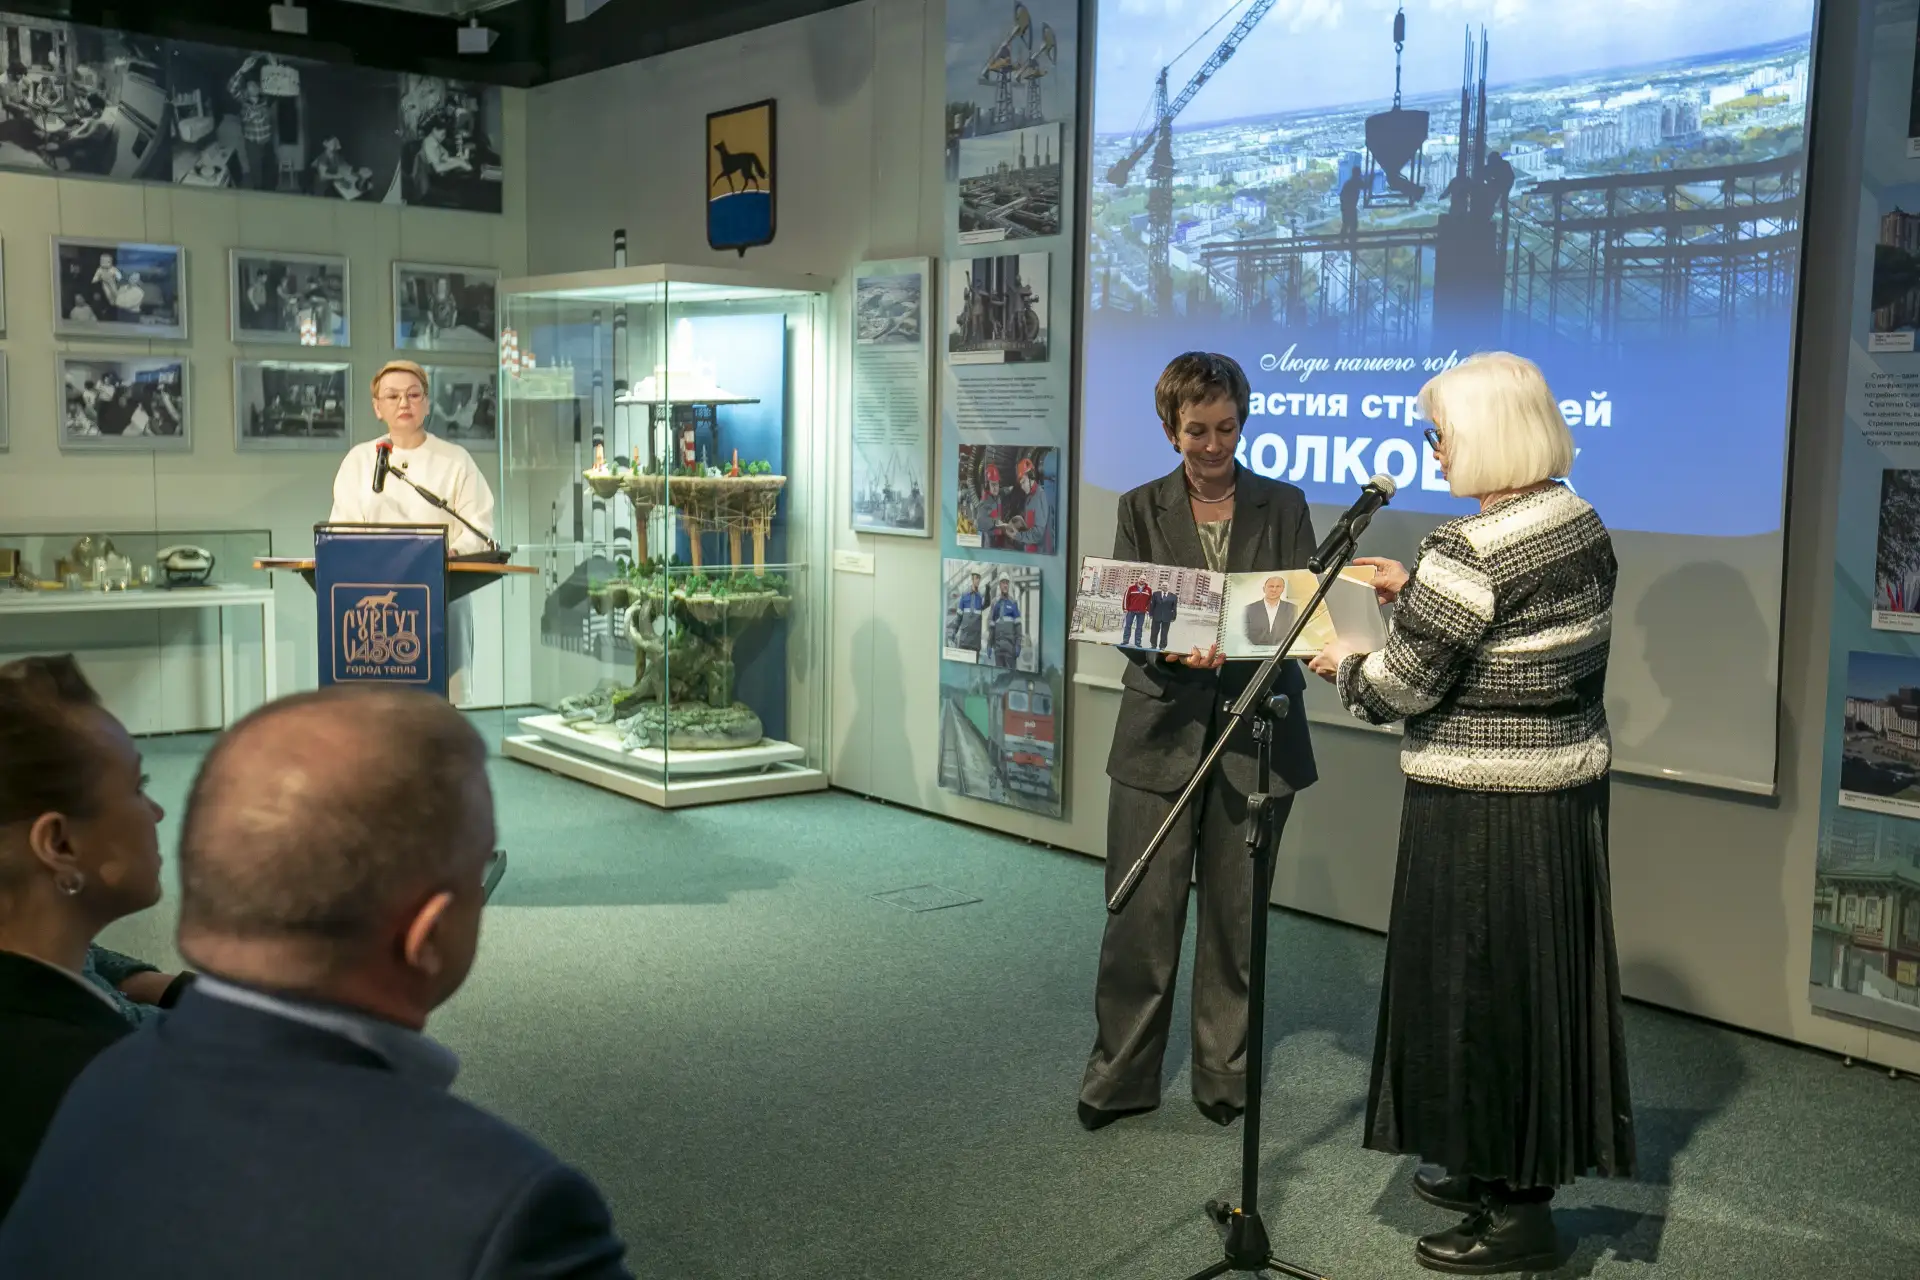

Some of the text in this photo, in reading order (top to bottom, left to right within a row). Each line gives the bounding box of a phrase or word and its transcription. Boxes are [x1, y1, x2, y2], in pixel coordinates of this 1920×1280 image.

[1259, 343, 1330, 383] Люди
[1333, 357, 1416, 372] нашего
[346, 665, 417, 676] город тепла
